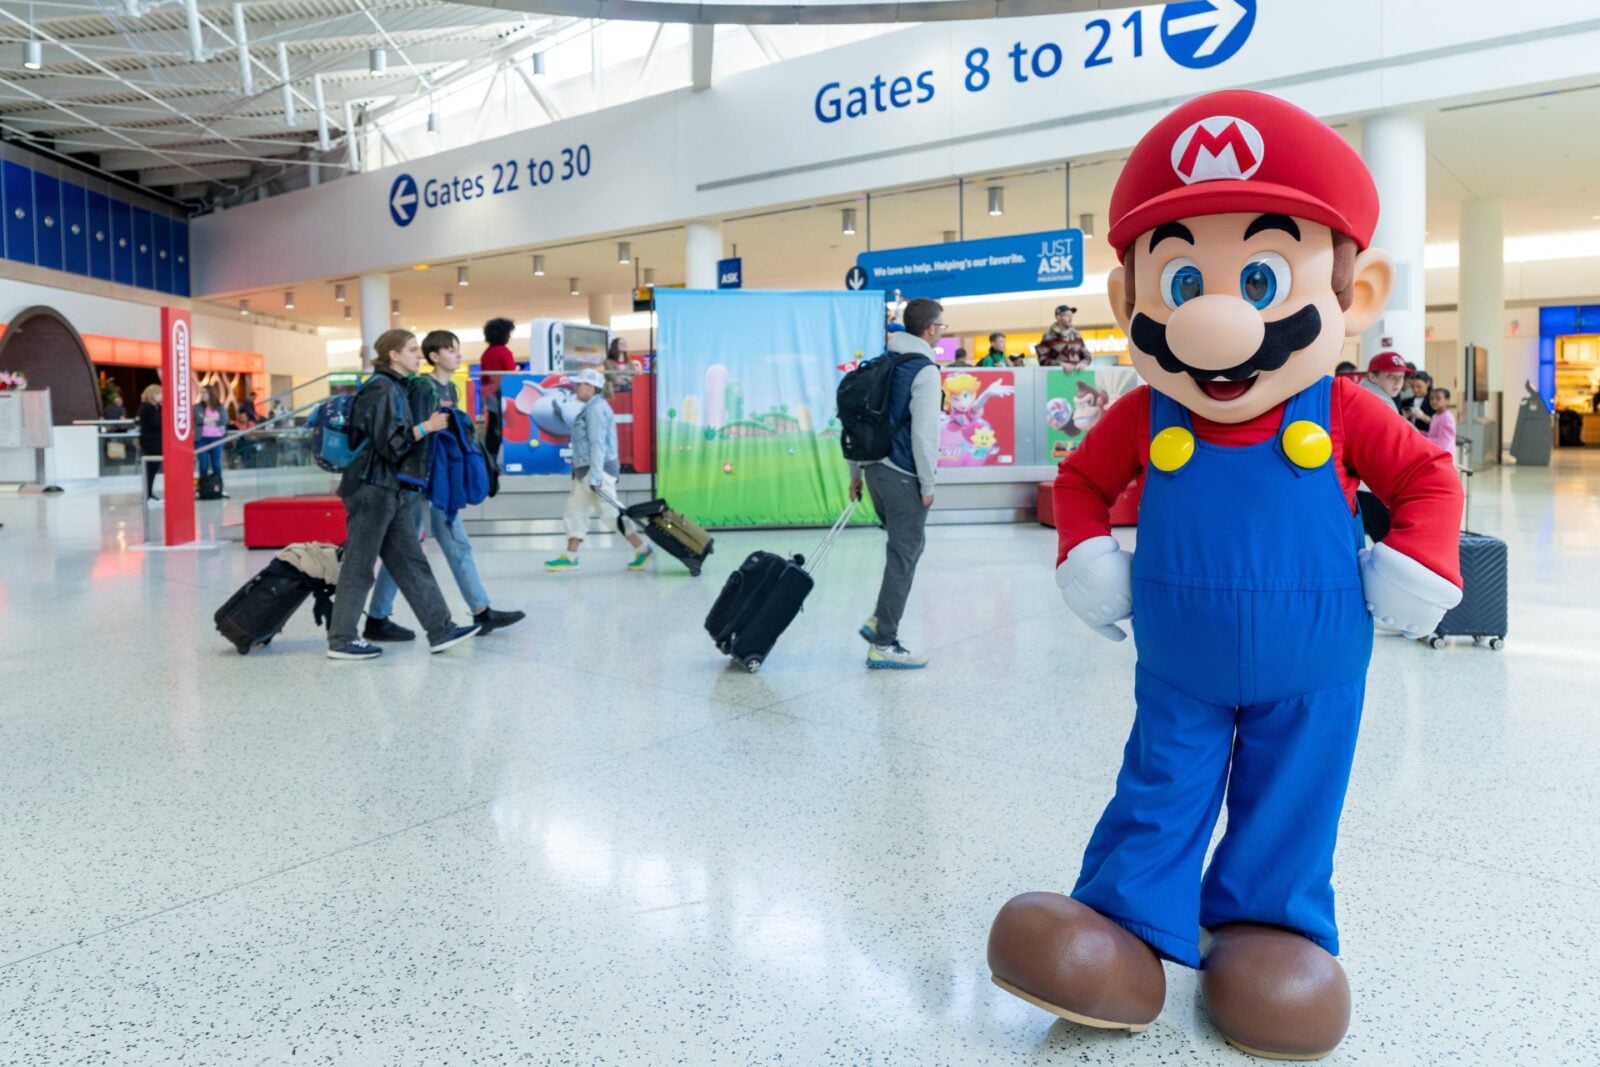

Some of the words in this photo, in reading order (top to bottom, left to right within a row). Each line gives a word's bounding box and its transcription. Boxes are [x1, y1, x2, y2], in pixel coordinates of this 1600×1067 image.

[814, 70, 936, 124] Gates
[963, 46, 991, 93] 8
[1008, 41, 1064, 83] to
[1083, 9, 1145, 69] 21
[1176, 120, 1258, 179] M
[424, 174, 485, 209] Gates
[492, 159, 520, 195] 22
[527, 157, 555, 187] to
[561, 144, 592, 182] 30
[873, 266, 887, 277] We
[886, 265, 903, 276] love
[903, 264, 913, 275] to
[912, 261, 934, 275] help.
[933, 258, 973, 272] Helping's
[972, 258, 988, 268] our
[988, 253, 1027, 267] favorite.
[1037, 237, 1075, 258] JUST
[1037, 254, 1074, 275] ASK
[720, 272, 739, 285] ASK
[176, 330, 187, 430] Nintendo
